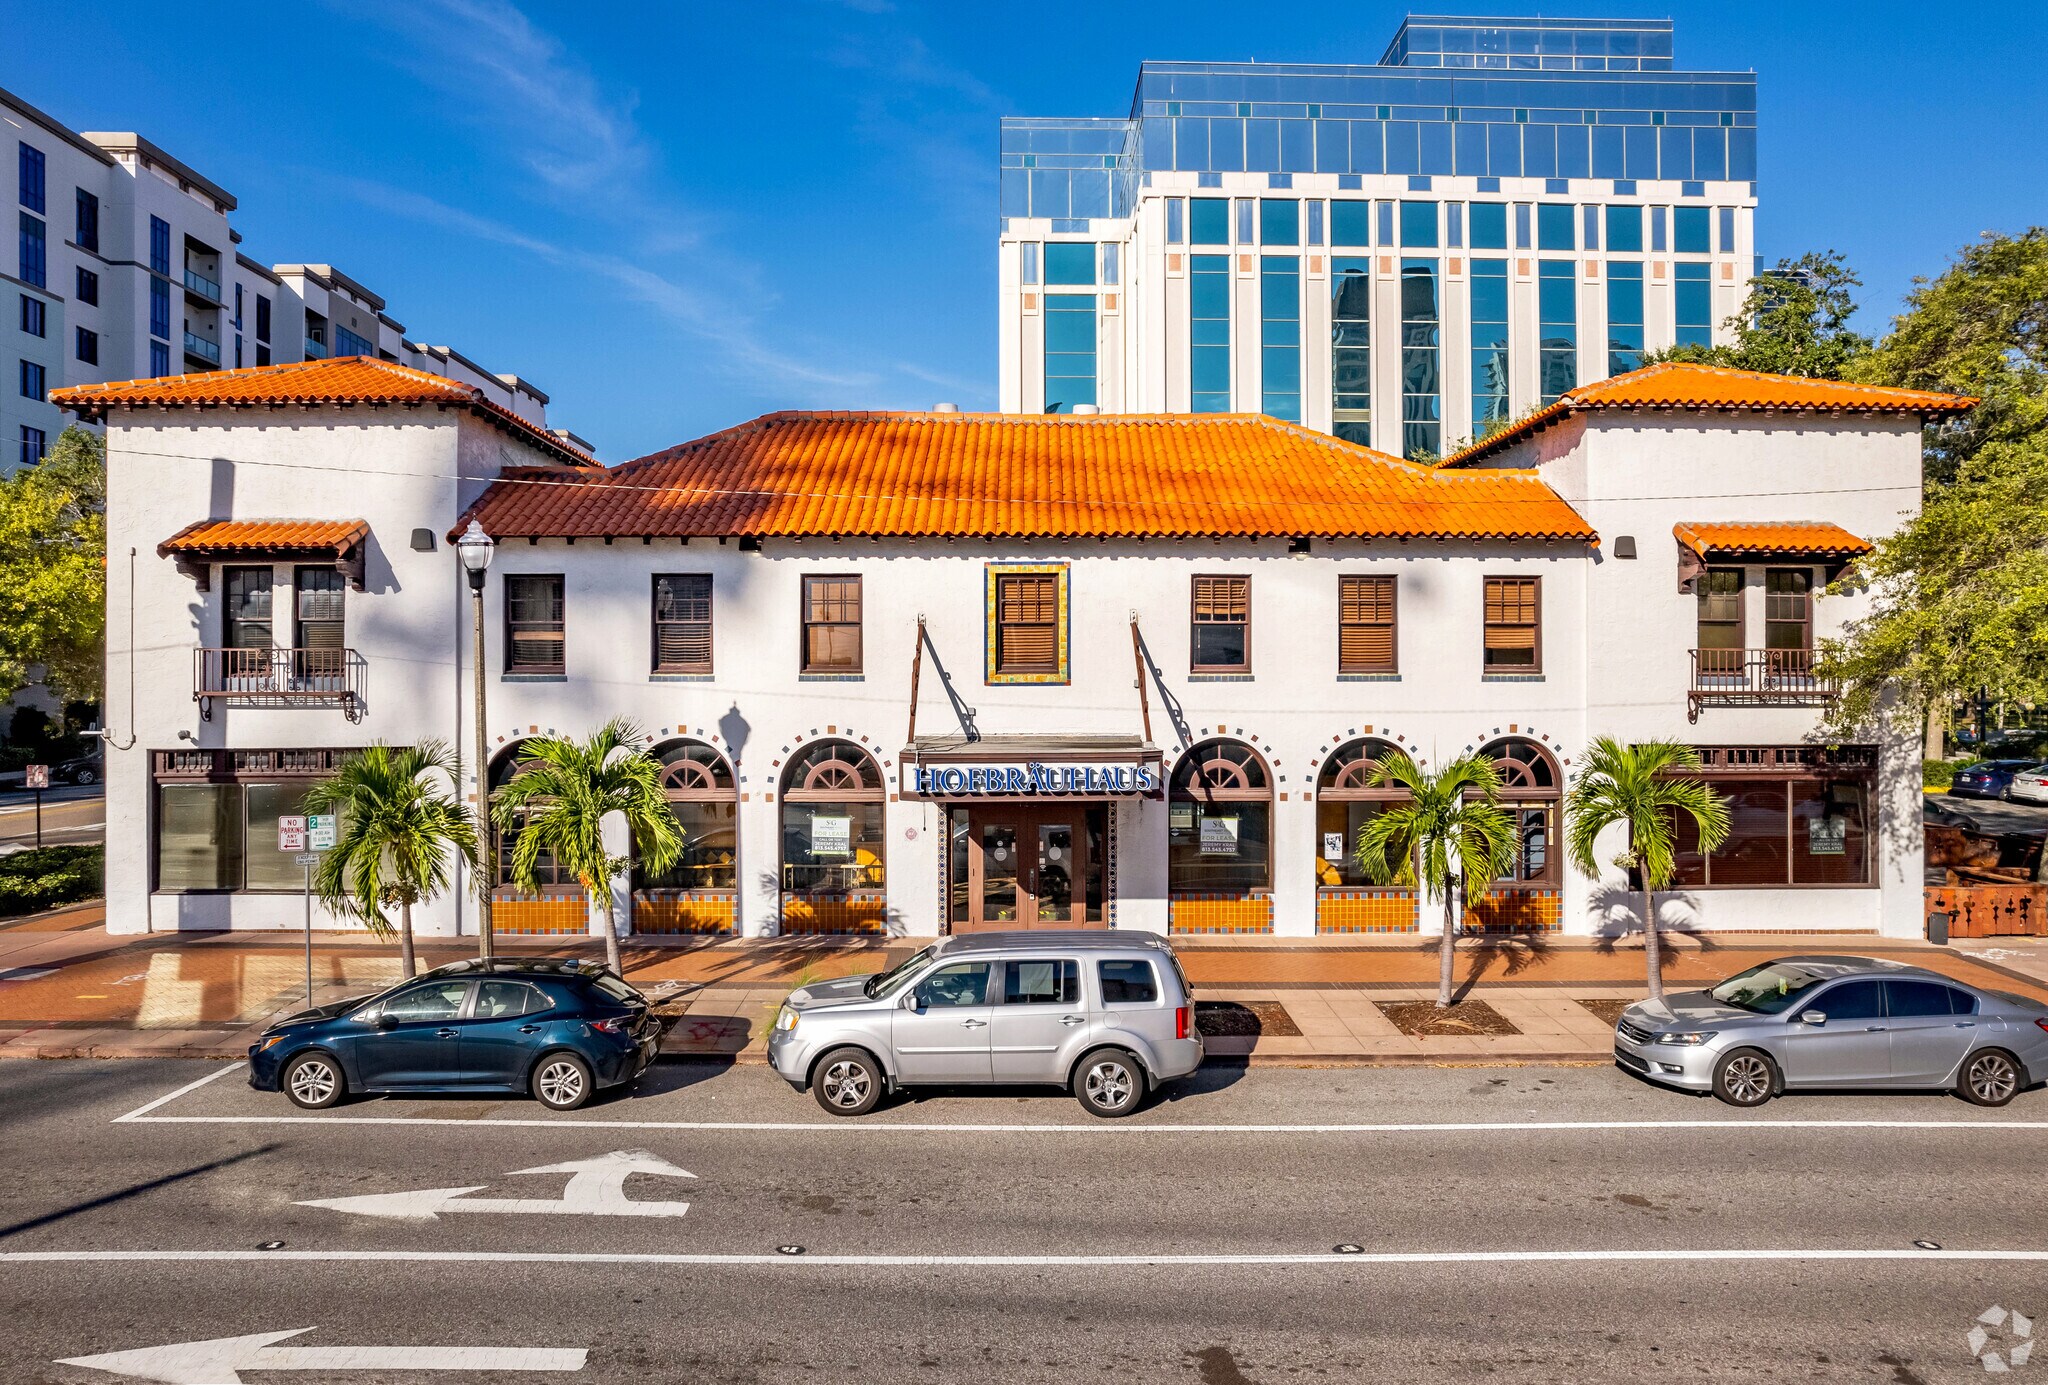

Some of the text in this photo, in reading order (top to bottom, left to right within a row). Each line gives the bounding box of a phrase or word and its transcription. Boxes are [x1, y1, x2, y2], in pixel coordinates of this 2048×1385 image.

[912, 763, 1151, 792] HOFBRÄUHAUS
[310, 819, 316, 827] 2
[281, 826, 303, 834] PARKING
